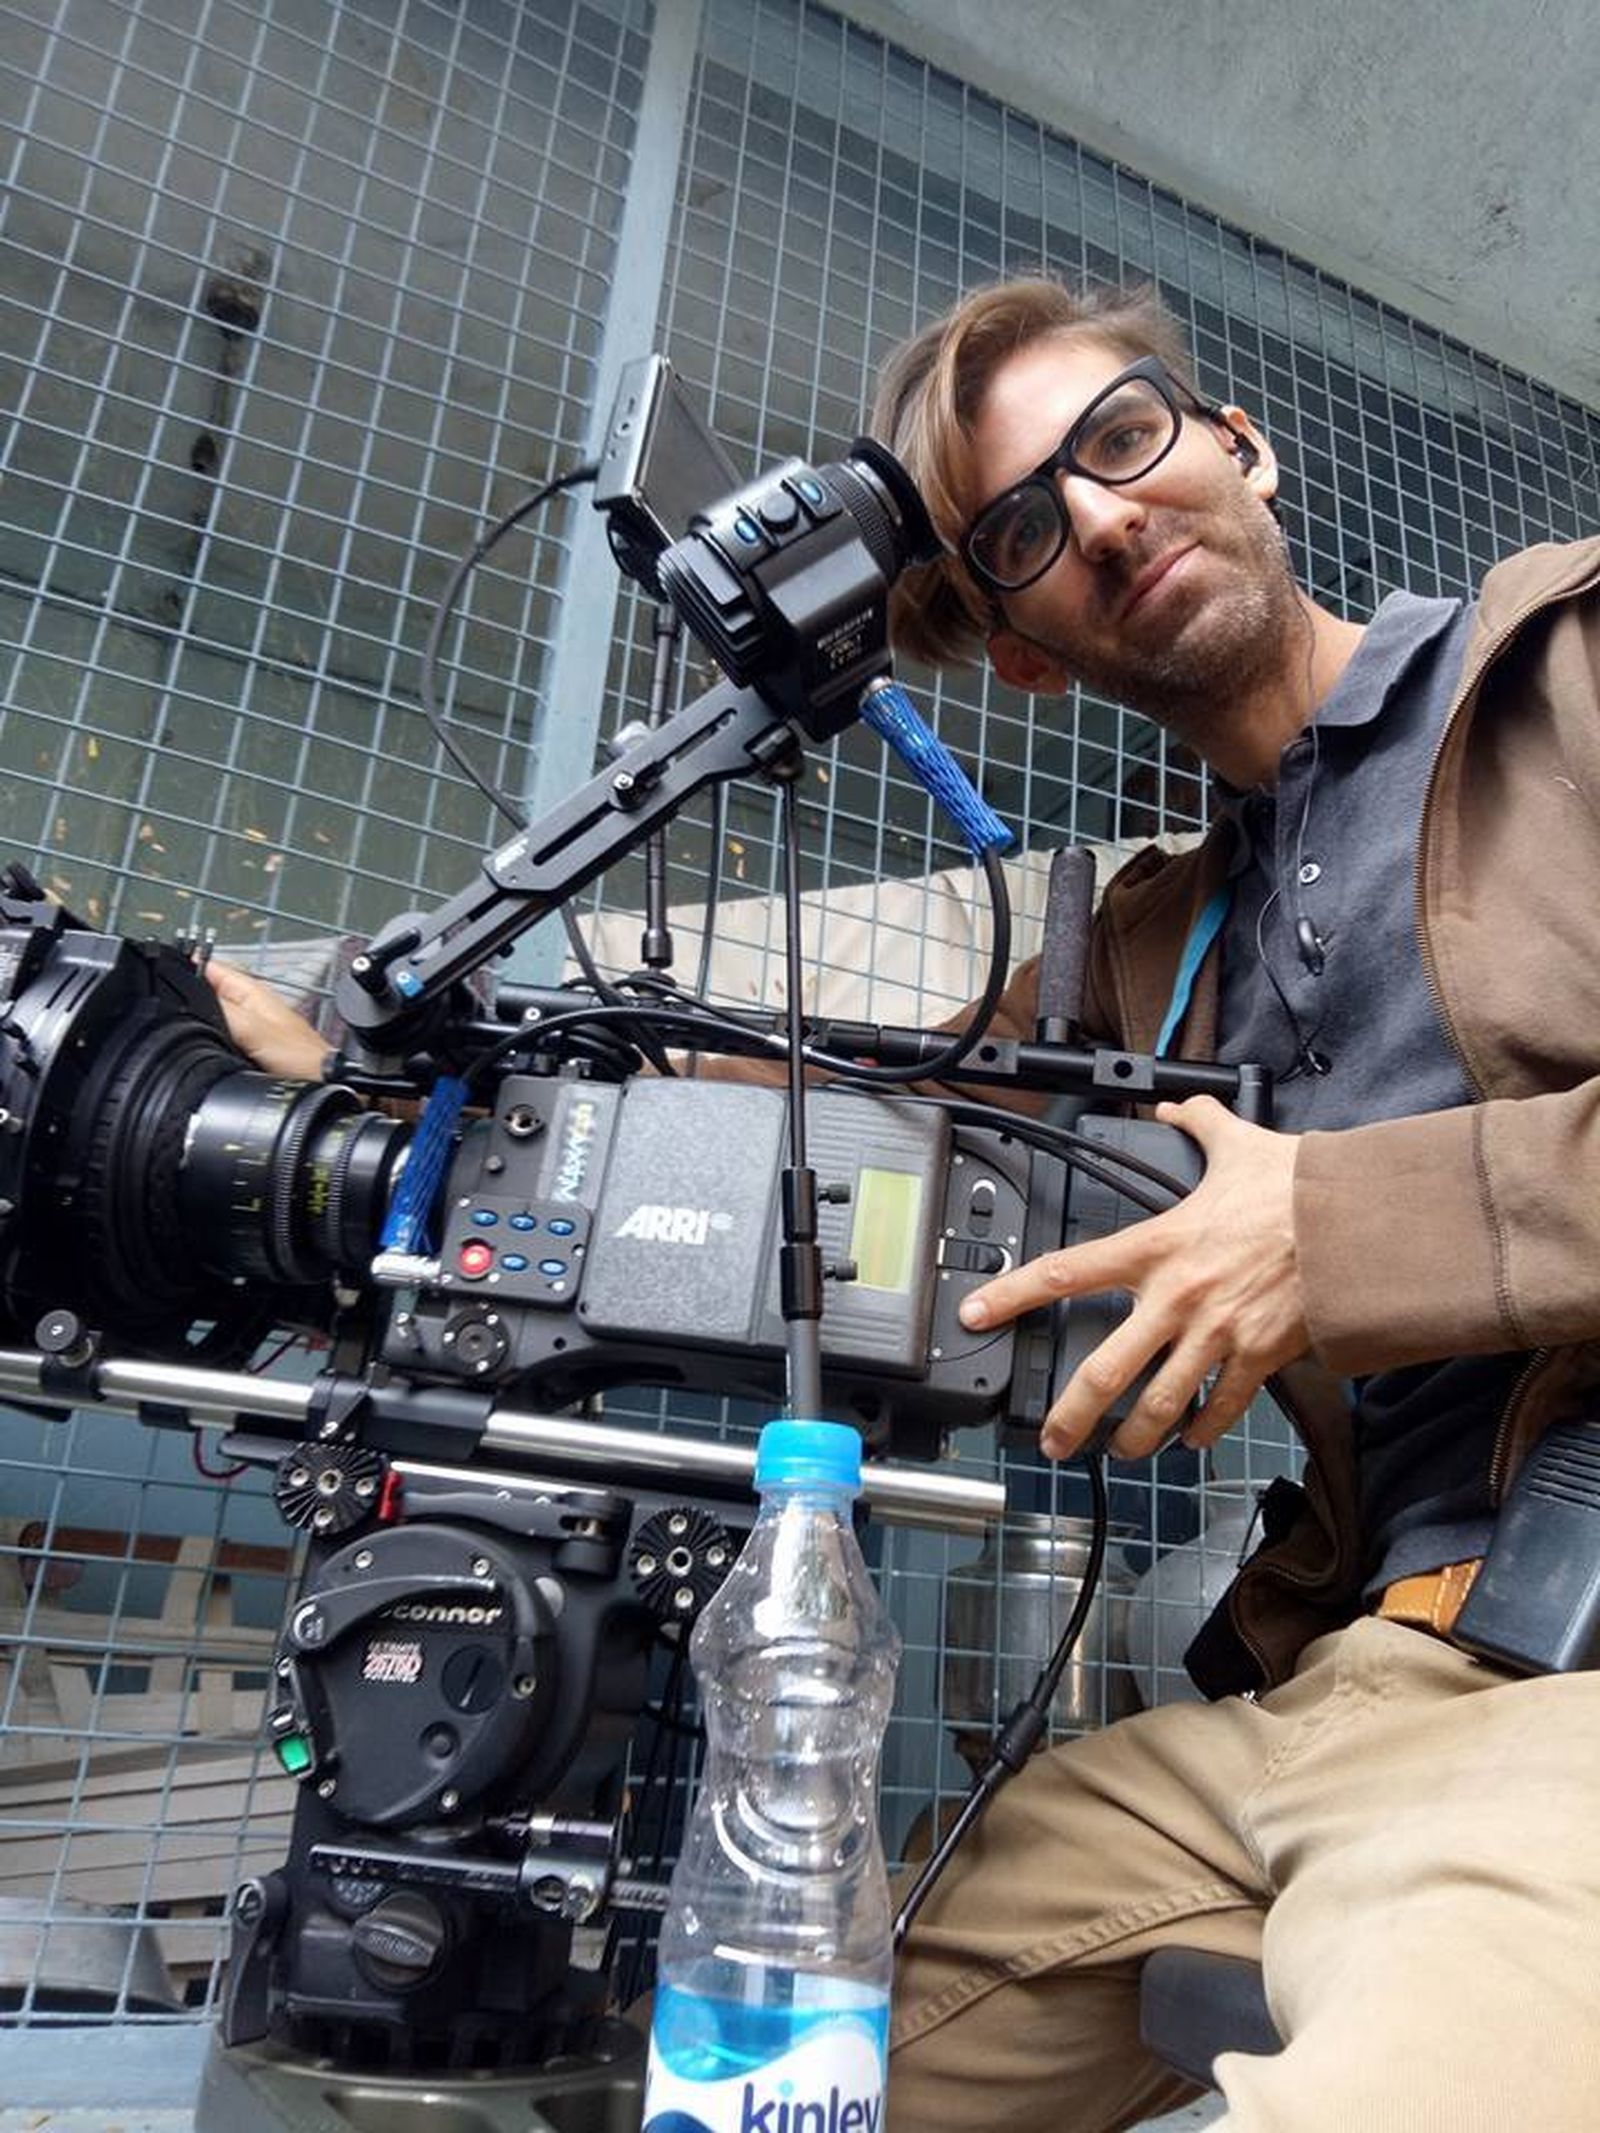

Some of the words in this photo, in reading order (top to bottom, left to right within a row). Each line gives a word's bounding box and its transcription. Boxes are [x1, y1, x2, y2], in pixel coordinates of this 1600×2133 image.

[612, 1205, 710, 1245] ARRI
[379, 1605, 503, 1625] connor
[741, 2082, 880, 2133] kinley
